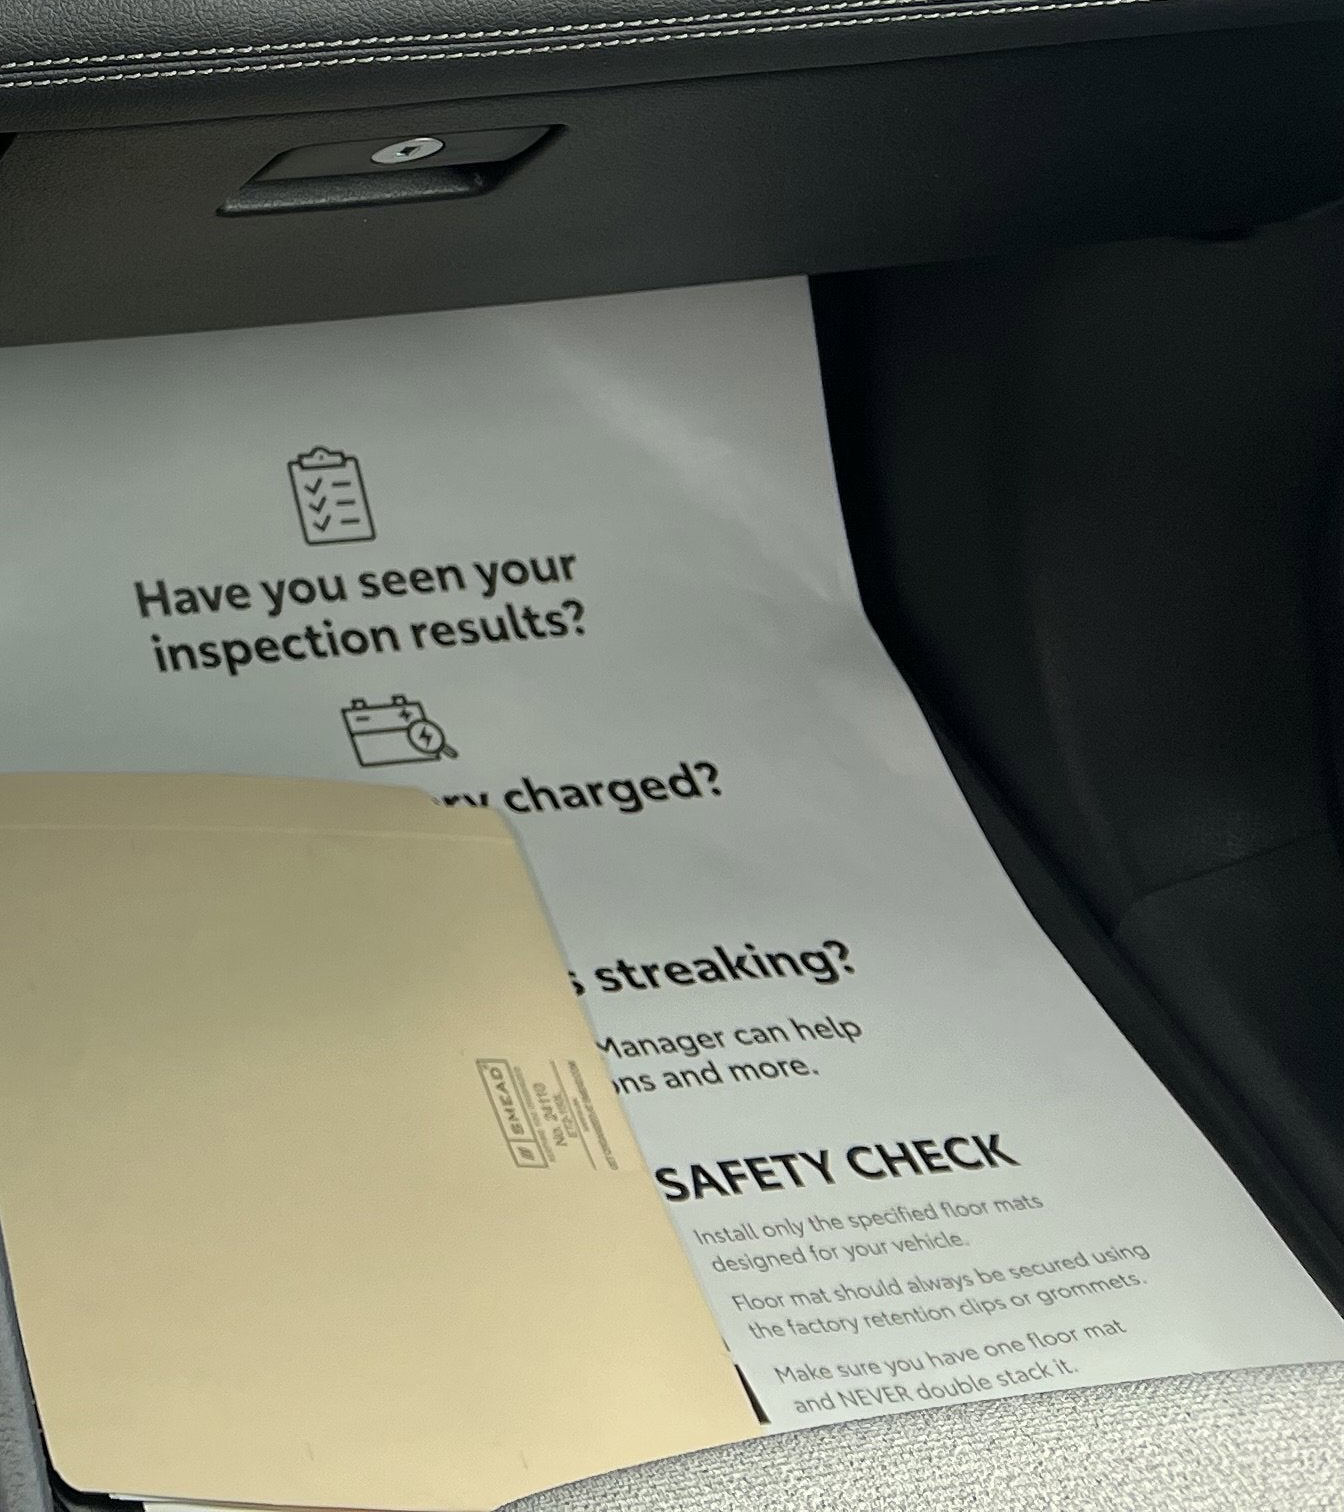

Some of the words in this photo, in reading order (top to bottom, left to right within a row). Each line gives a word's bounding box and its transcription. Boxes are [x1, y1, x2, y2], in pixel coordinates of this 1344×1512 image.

[134, 576, 252, 618] Have
[260, 574, 347, 616] you
[358, 561, 466, 599] seen
[474, 553, 577, 598] your
[152, 619, 400, 675] inspection
[410, 599, 588, 649] results?
[503, 761, 722, 815] charged?
[594, 939, 856, 991] streaking?
[654, 1147, 840, 1203] SAFETY
[846, 1133, 1022, 1182] CHECK
[732, 1292, 786, 1313] Floor
[791, 1288, 830, 1307] mat
[834, 1278, 902, 1300] should
[907, 1270, 975, 1296] always
[978, 1267, 1006, 1284] be
[1008, 1252, 1089, 1279] secured
[1092, 1242, 1151, 1267] using
[749, 1322, 784, 1341] the
[787, 1315, 860, 1340] factory
[864, 1304, 956, 1329] retention
[959, 1298, 1007, 1319] clips
[1010, 1292, 1032, 1306] or
[1037, 1274, 1148, 1306] grommets.
[774, 1363, 832, 1385] Make
[837, 1359, 883, 1377] sure
[885, 1355, 925, 1377] you
[925, 1346, 980, 1368] have
[983, 1340, 1023, 1356] one
[1027, 1329, 1079, 1350] floor
[1083, 1319, 1127, 1340] mat
[794, 1394, 835, 1415] and
[839, 1386, 915, 1410] NEVER
[915, 1374, 993, 1399] double
[996, 1363, 1053, 1386] stack
[1055, 1359, 1078, 1376] it.
